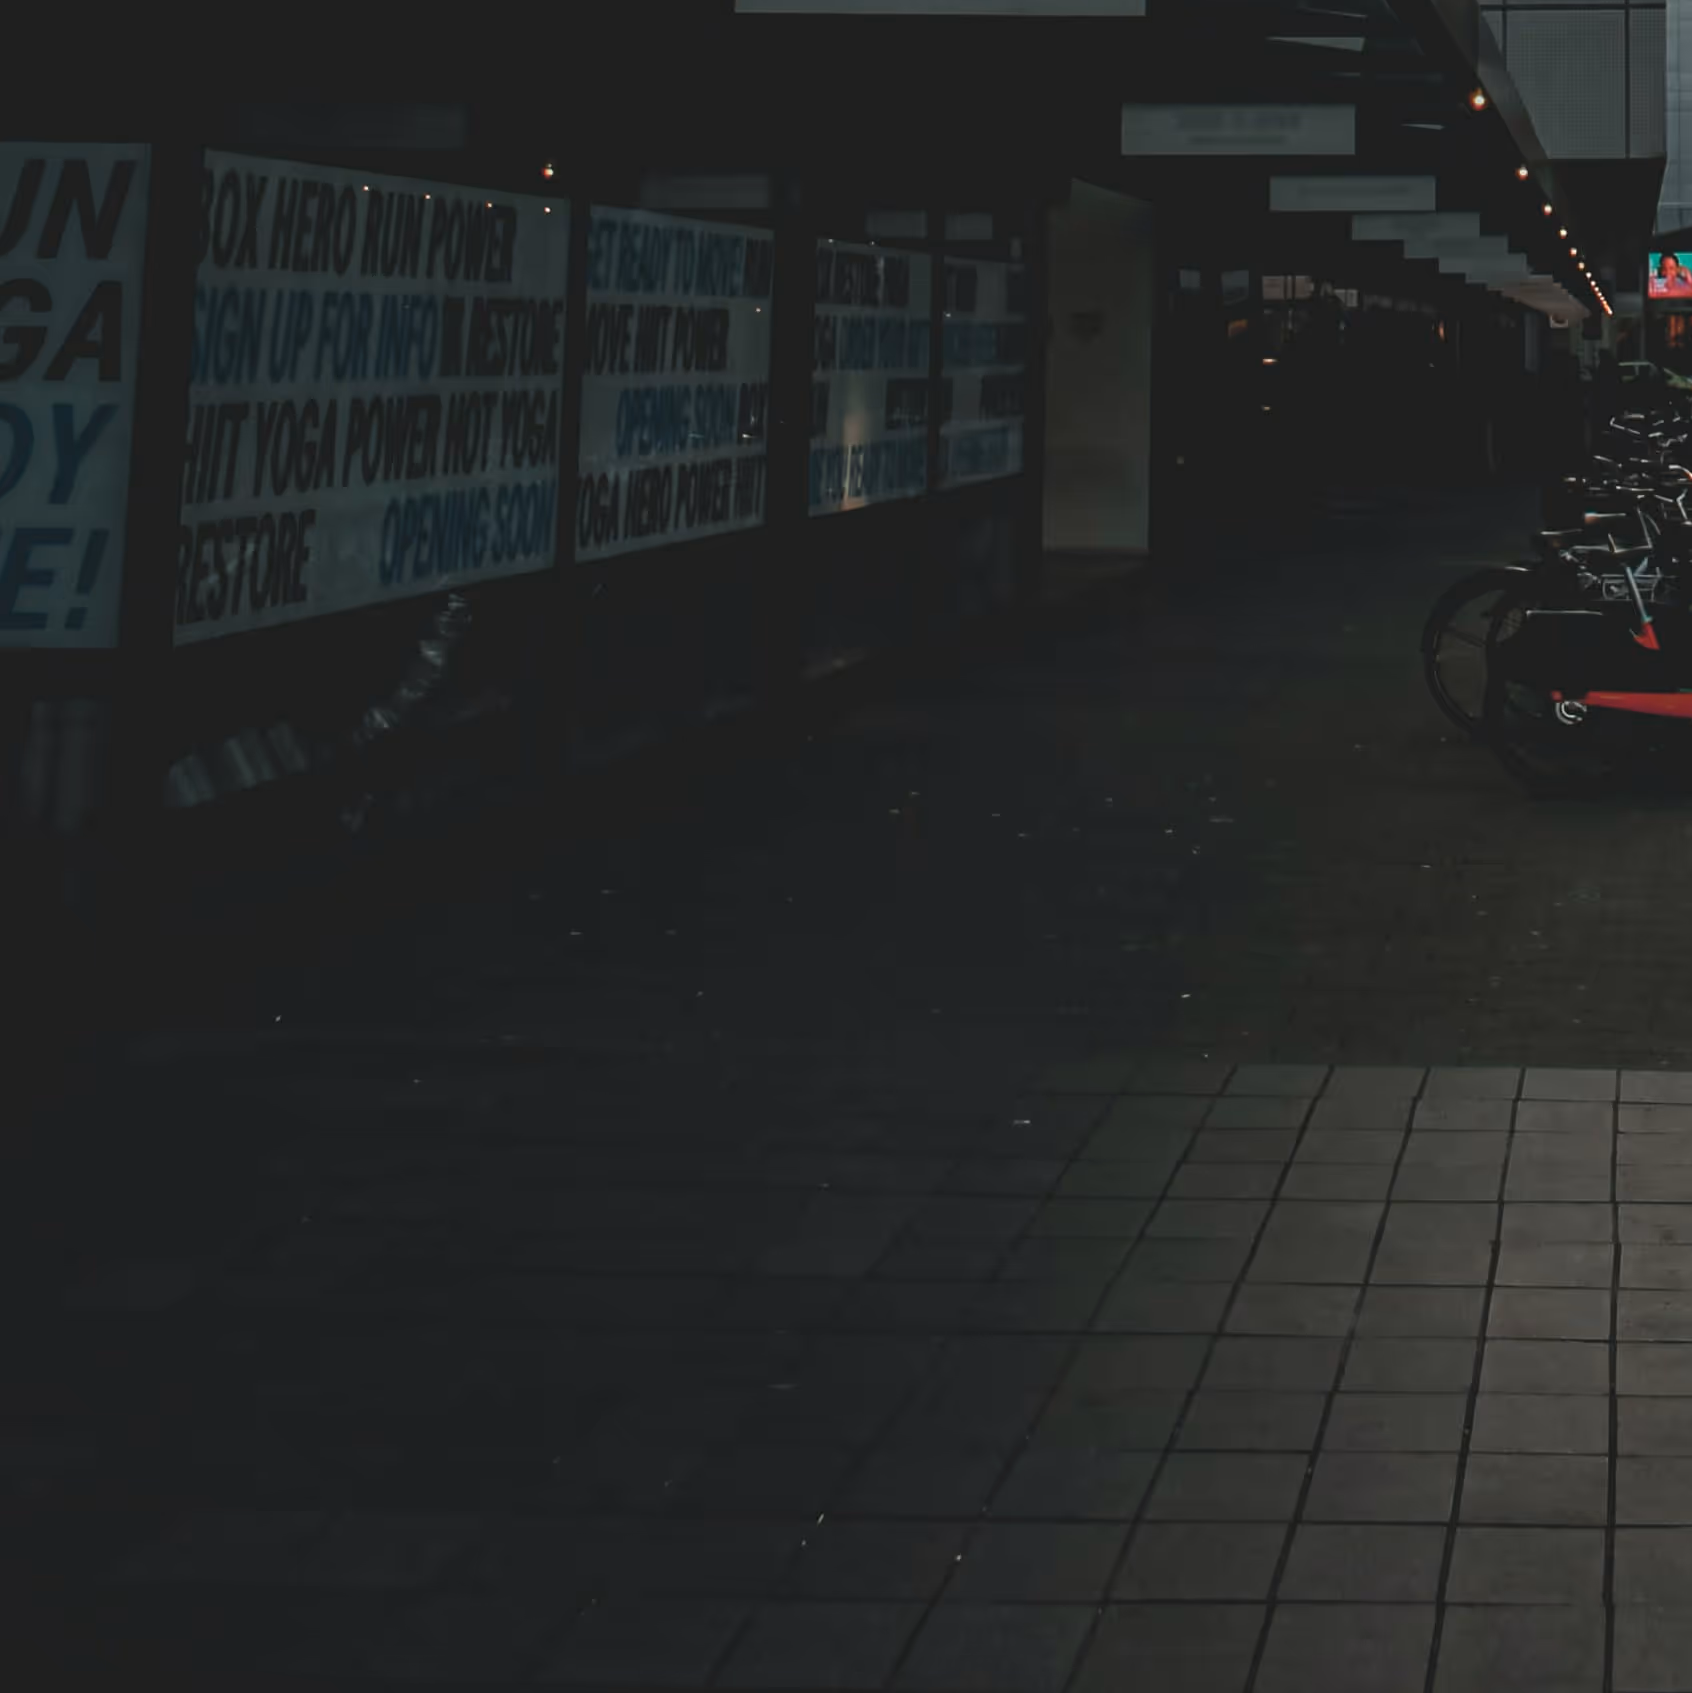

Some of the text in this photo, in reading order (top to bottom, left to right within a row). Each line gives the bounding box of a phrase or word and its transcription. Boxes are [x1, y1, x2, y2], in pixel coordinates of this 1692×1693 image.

[268, 175, 357, 279] HERO
[360, 186, 424, 279] RUN
[191, 285, 268, 385] SIGN
[268, 287, 313, 384] UP
[314, 291, 375, 382] FOR
[374, 291, 440, 381] INFO
[253, 397, 338, 497] YOGA
[342, 392, 443, 488] POWER
[442, 390, 500, 475] HOT
[499, 385, 556, 469] YOGA
[174, 478, 556, 626] RESTORE OPENING SOON
